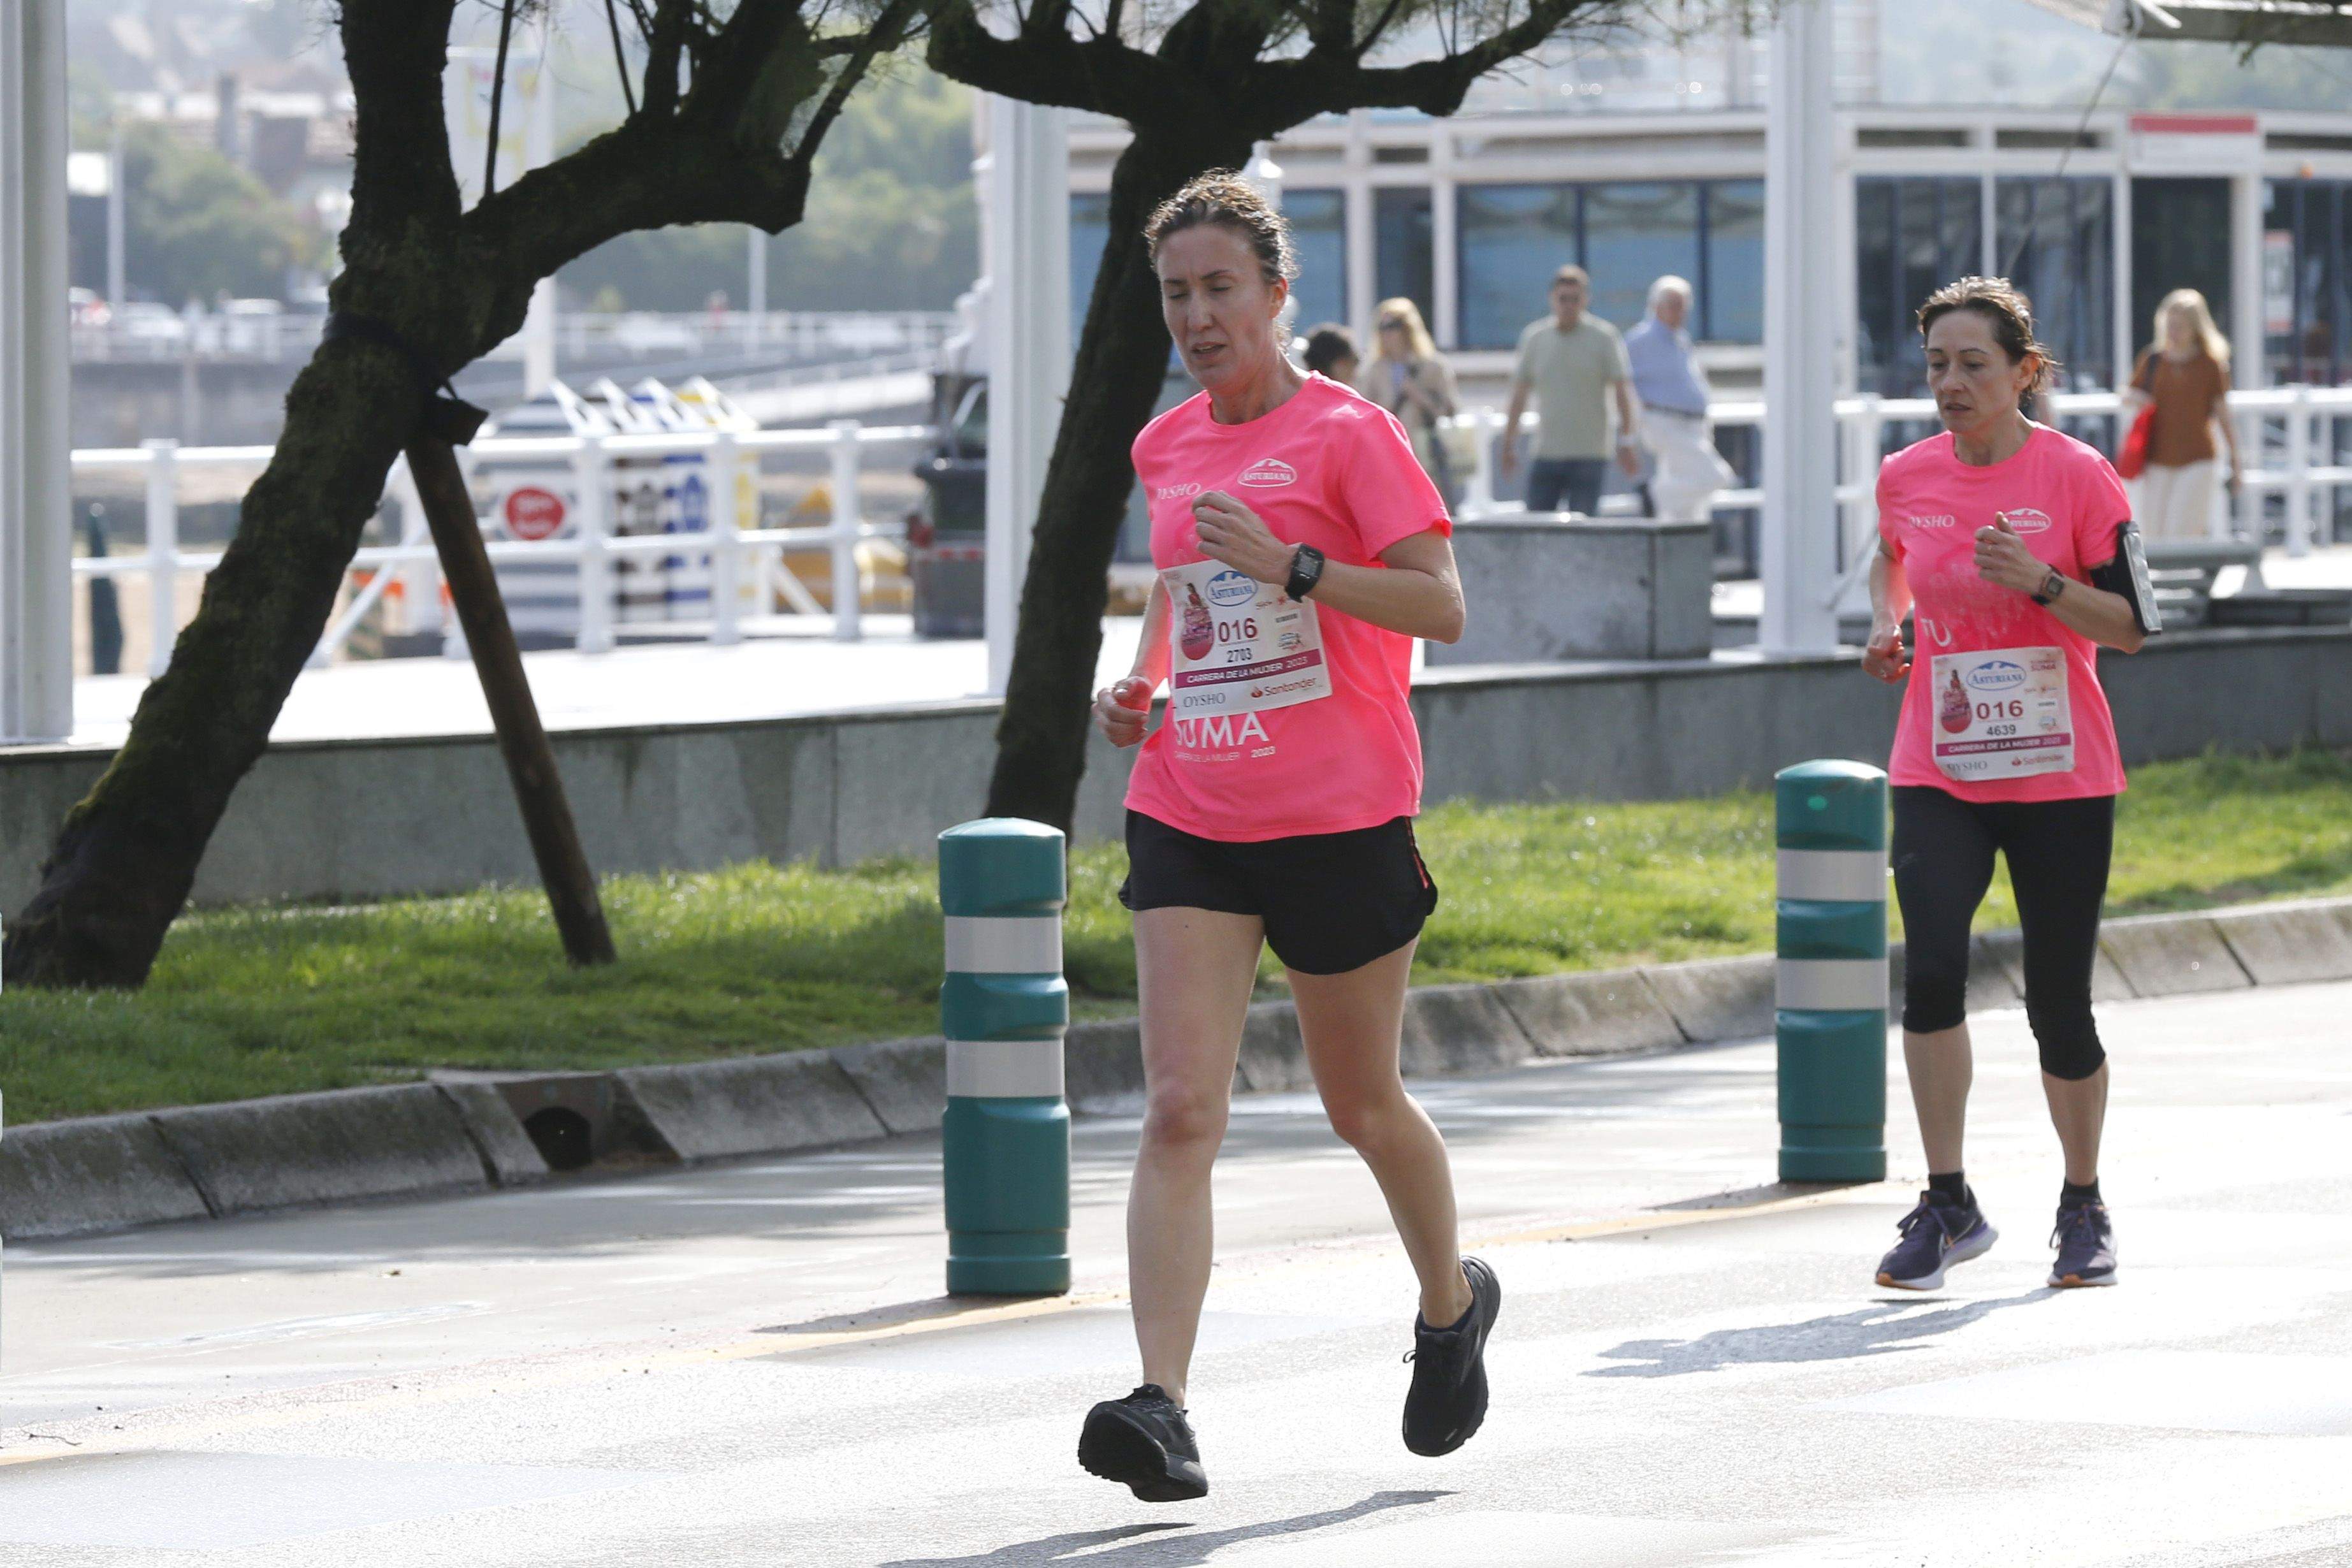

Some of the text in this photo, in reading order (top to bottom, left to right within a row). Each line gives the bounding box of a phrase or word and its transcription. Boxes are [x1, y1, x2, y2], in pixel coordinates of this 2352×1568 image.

[1218, 617, 1258, 643] 016
[1226, 647, 1253, 664] 2703
[1186, 671, 1225, 683] CARRERA
[1225, 669, 1238, 679] DE
[1238, 668, 1249, 677] LA
[1264, 677, 1317, 696] Santander
[1183, 692, 1226, 708] OYSHO
[1977, 699, 2024, 720] 016
[1986, 724, 2017, 736] 4639
[2000, 740, 2012, 749] LA
